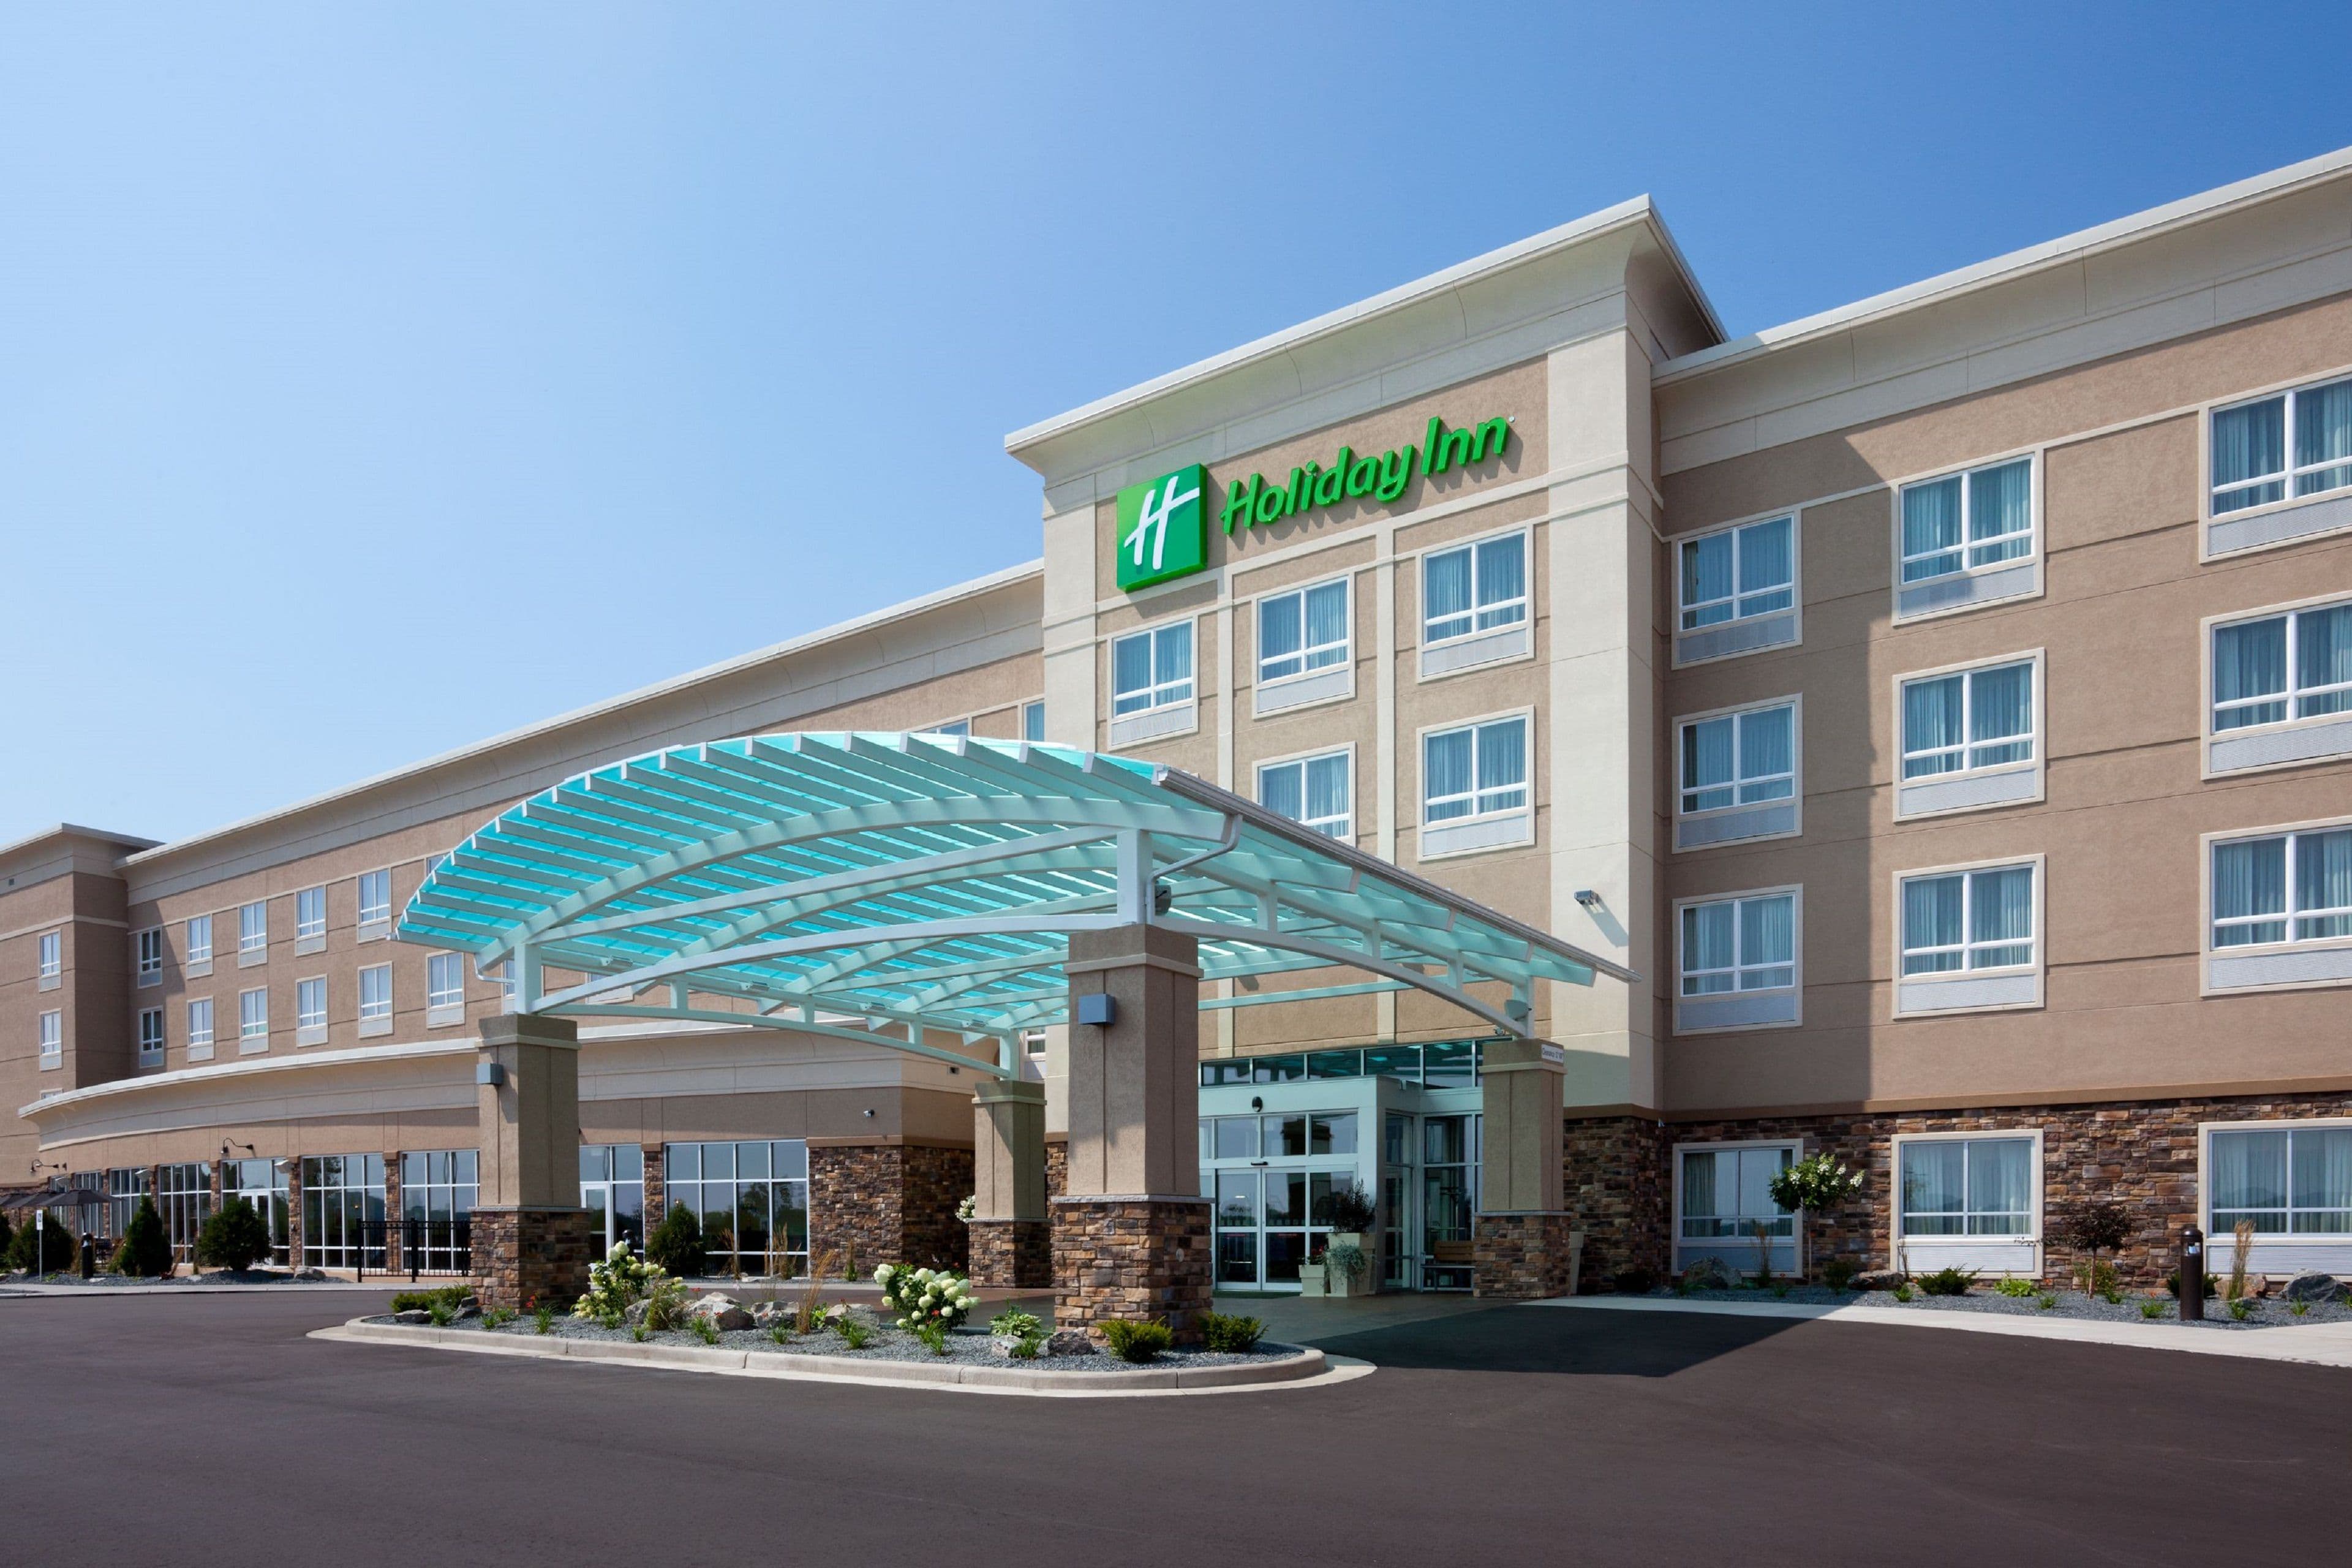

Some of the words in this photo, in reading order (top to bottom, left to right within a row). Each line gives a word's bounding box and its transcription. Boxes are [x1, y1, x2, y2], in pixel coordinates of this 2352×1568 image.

[1124, 475, 1200, 570] H
[1219, 445, 1415, 536] Holiday
[1420, 417, 1508, 477] Inn
